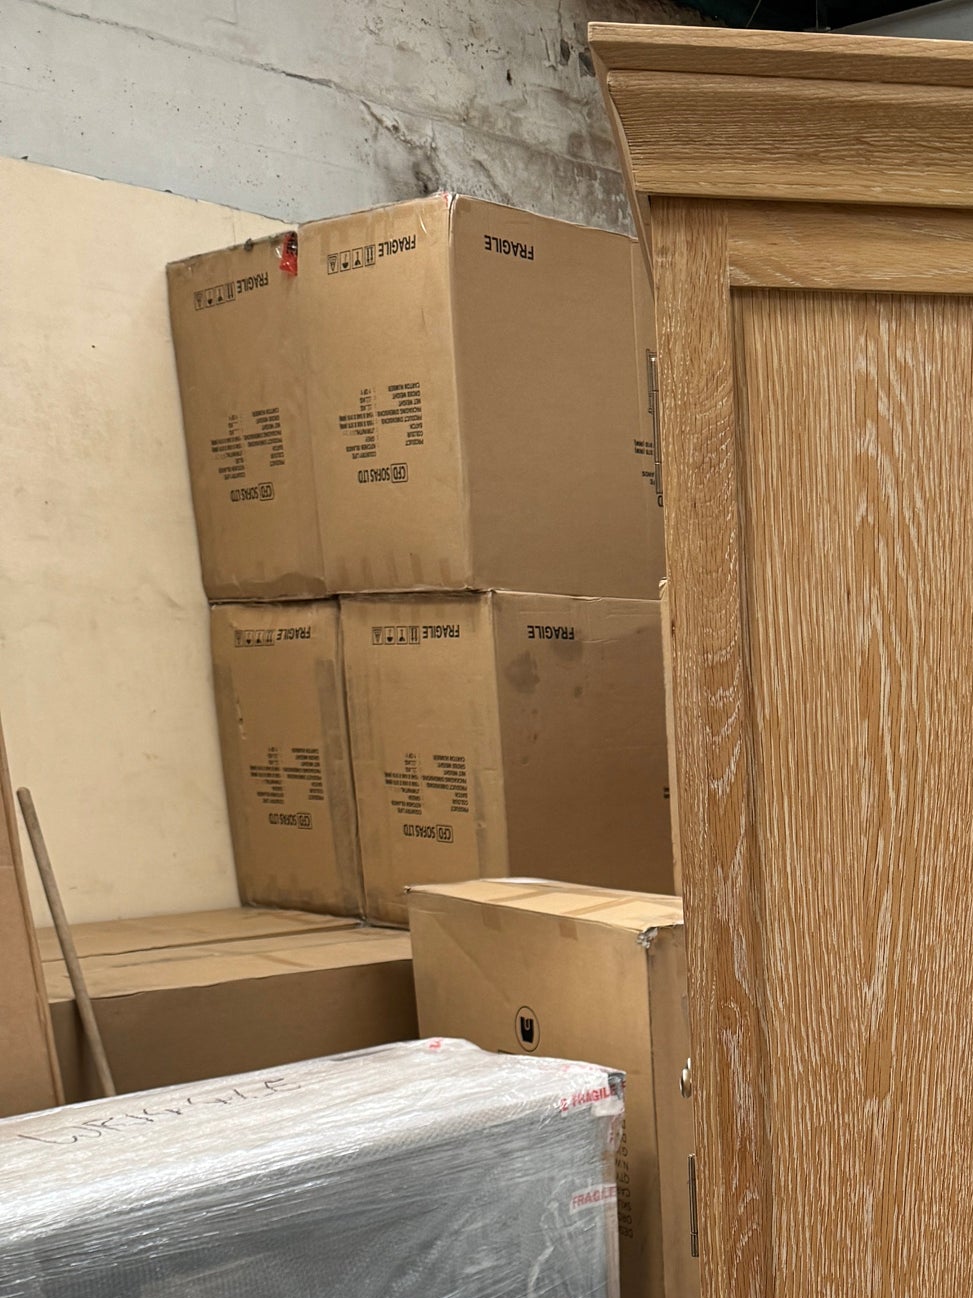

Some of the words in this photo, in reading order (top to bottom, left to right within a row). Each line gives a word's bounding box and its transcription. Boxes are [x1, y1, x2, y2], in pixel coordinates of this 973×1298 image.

[378, 234, 417, 257] FRAGILE
[484, 234, 534, 261] FRAGILE
[237, 272, 269, 293] FRAGILE
[358, 469, 369, 483] LTD
[371, 467, 390, 482] SOFAS
[392, 465, 407, 481] CFD
[276, 625, 311, 641] FRAGILE
[423, 624, 460, 640] FRAGILE
[528, 625, 575, 640] FRAGILE
[403, 824, 414, 837] LTD
[415, 825, 436, 839] SOFAS
[438, 827, 452, 840] CFD
